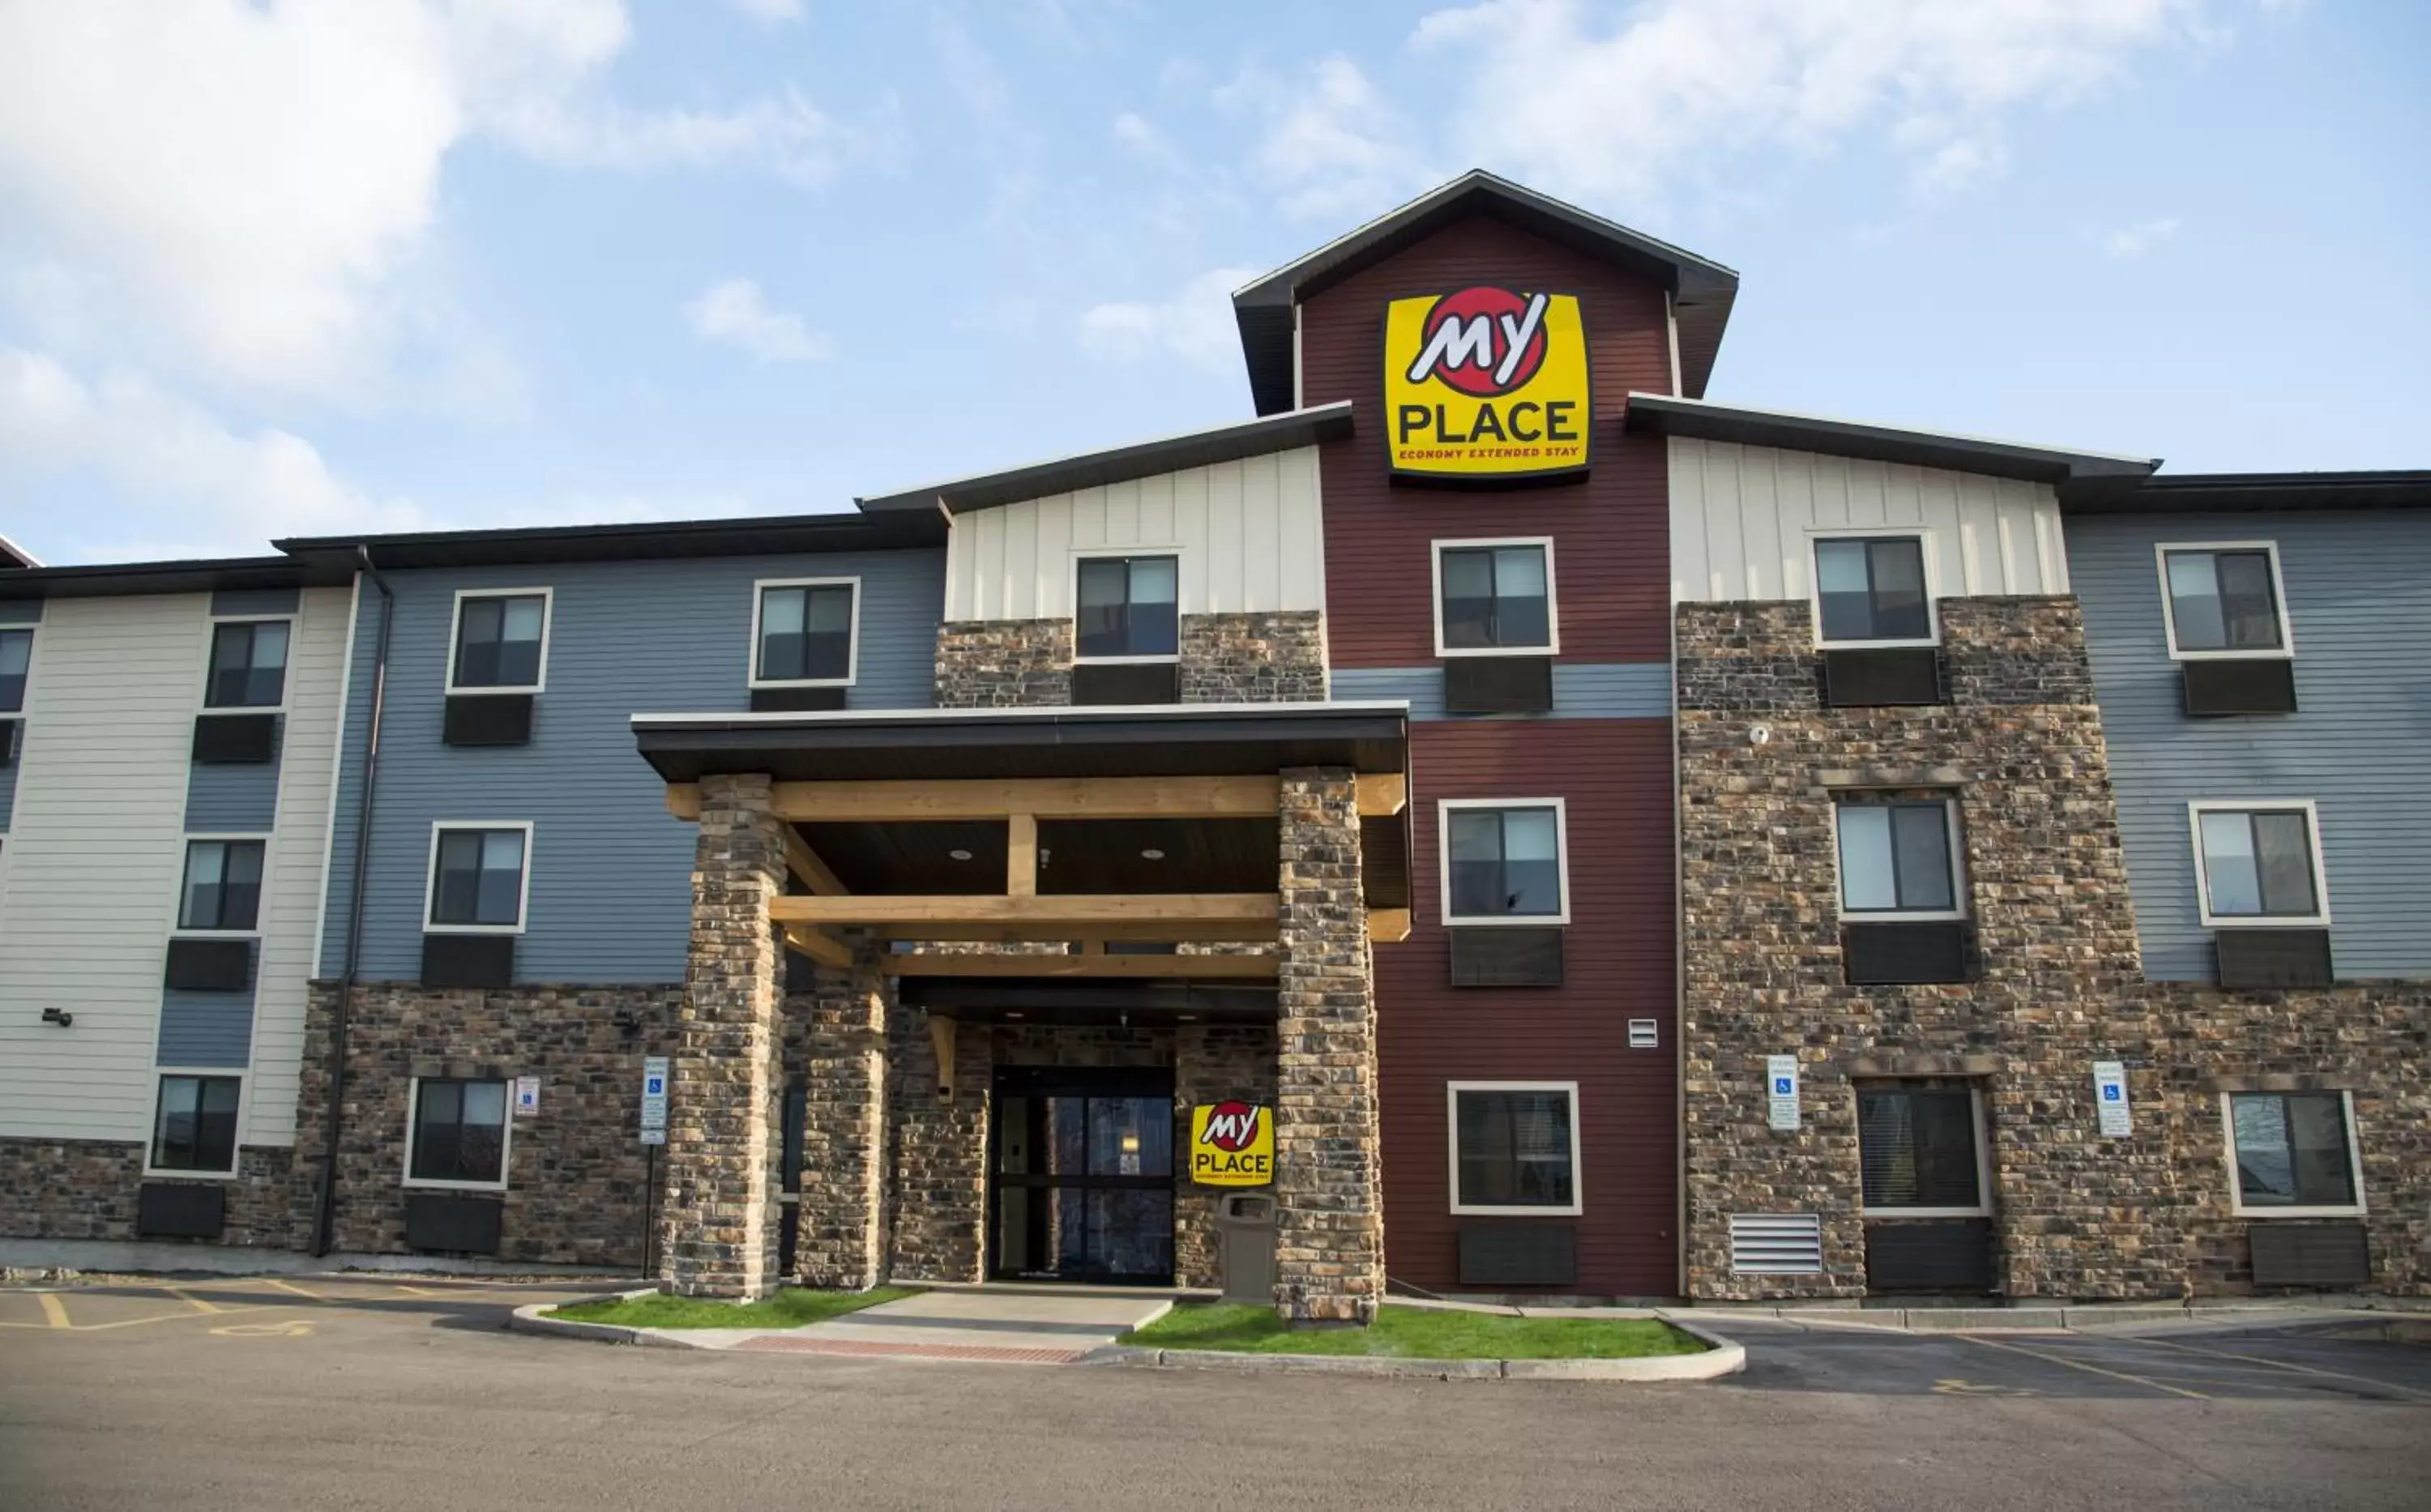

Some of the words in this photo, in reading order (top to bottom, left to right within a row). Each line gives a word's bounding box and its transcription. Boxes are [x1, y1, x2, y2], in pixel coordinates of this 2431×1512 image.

[1399, 402, 1578, 444] PLACE
[1399, 450, 1463, 459] ECONOMY
[1468, 448, 1539, 459] EXTENDED
[1545, 446, 1579, 456] STAY
[1196, 1154, 1269, 1172] PLACE
